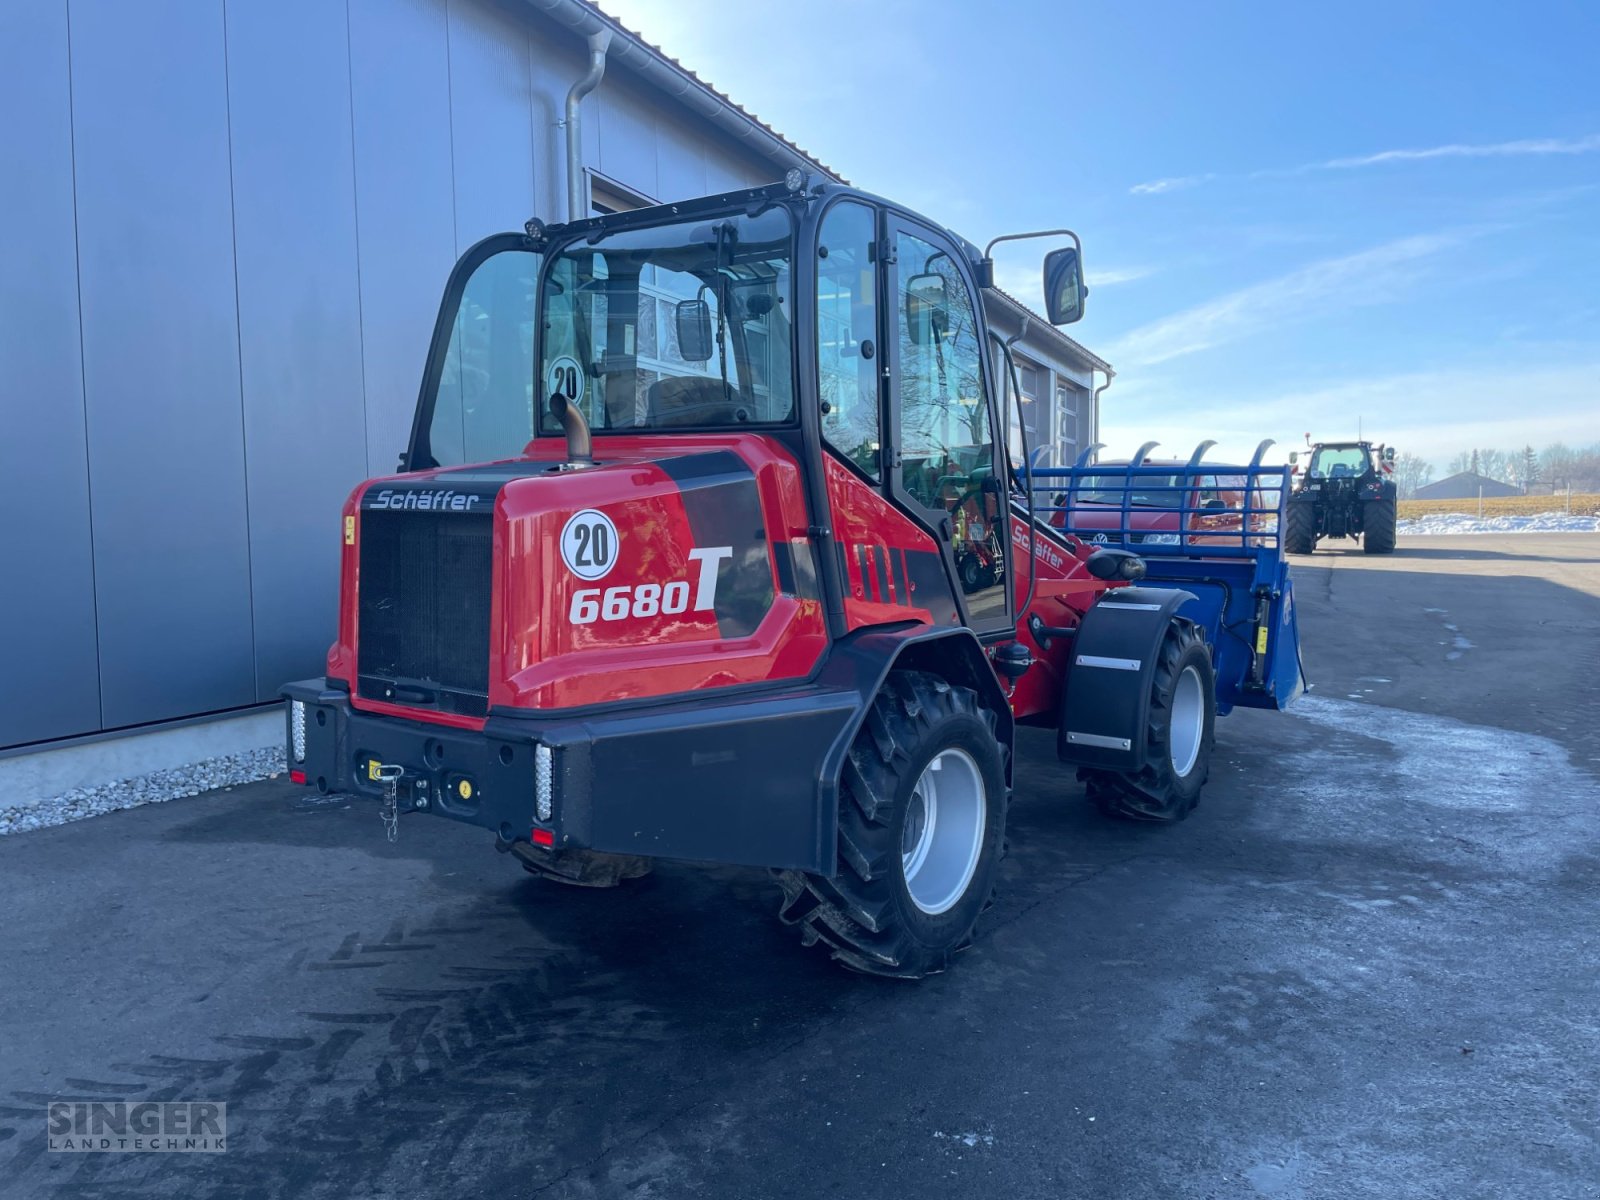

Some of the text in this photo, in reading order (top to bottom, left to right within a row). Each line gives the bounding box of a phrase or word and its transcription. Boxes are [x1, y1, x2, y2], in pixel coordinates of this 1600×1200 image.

[555, 366, 577, 400] 20
[370, 490, 479, 510] Schäffer
[574, 523, 609, 567] 20
[1012, 525, 1063, 568] Scäffer
